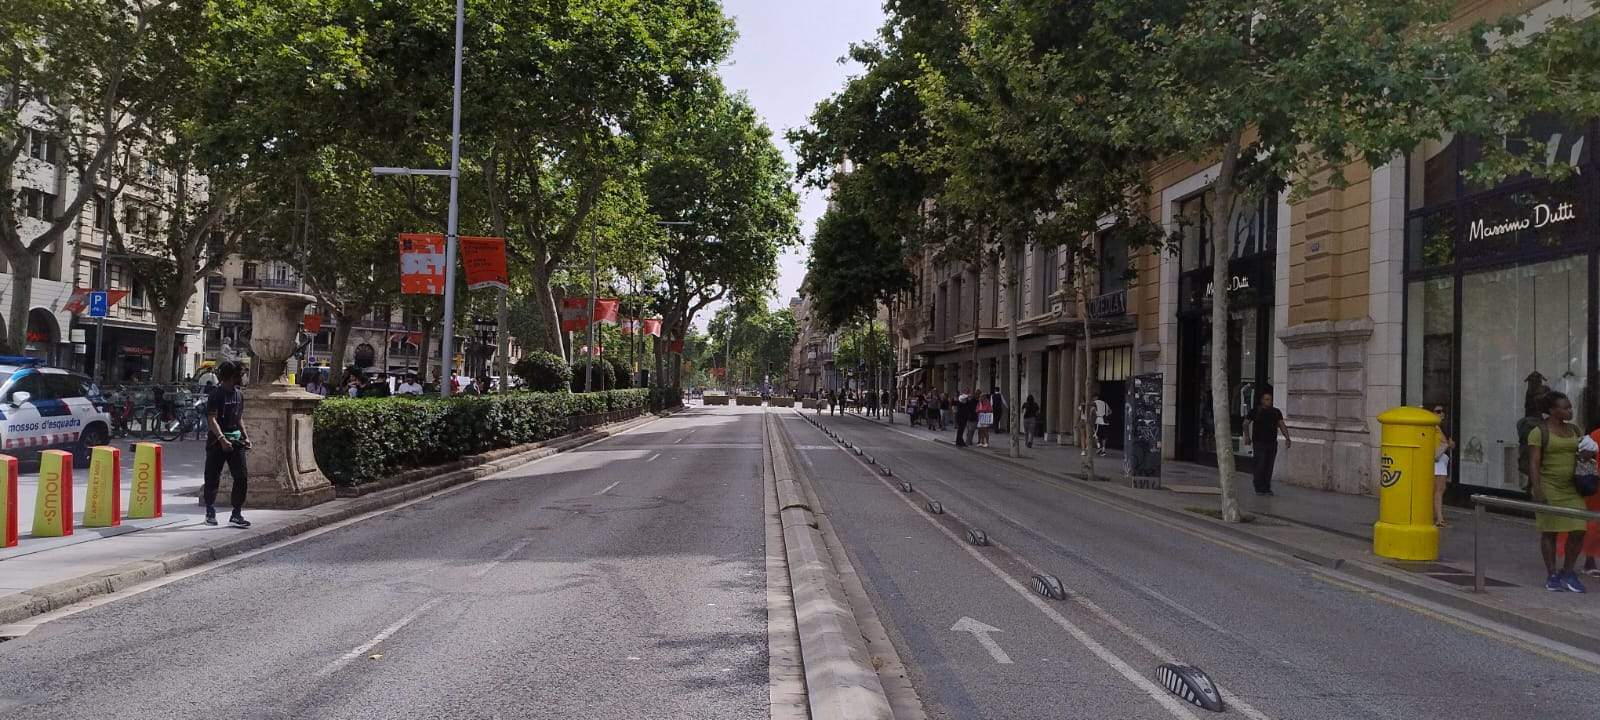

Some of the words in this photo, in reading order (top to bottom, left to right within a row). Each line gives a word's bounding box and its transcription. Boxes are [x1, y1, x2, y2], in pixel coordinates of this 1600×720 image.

[1469, 218, 1529, 242] Massimo
[1533, 202, 1575, 228] Dutti
[94, 295, 102, 305] P
[8, 422, 39, 433] mossos
[41, 417, 80, 431] d'esquadra
